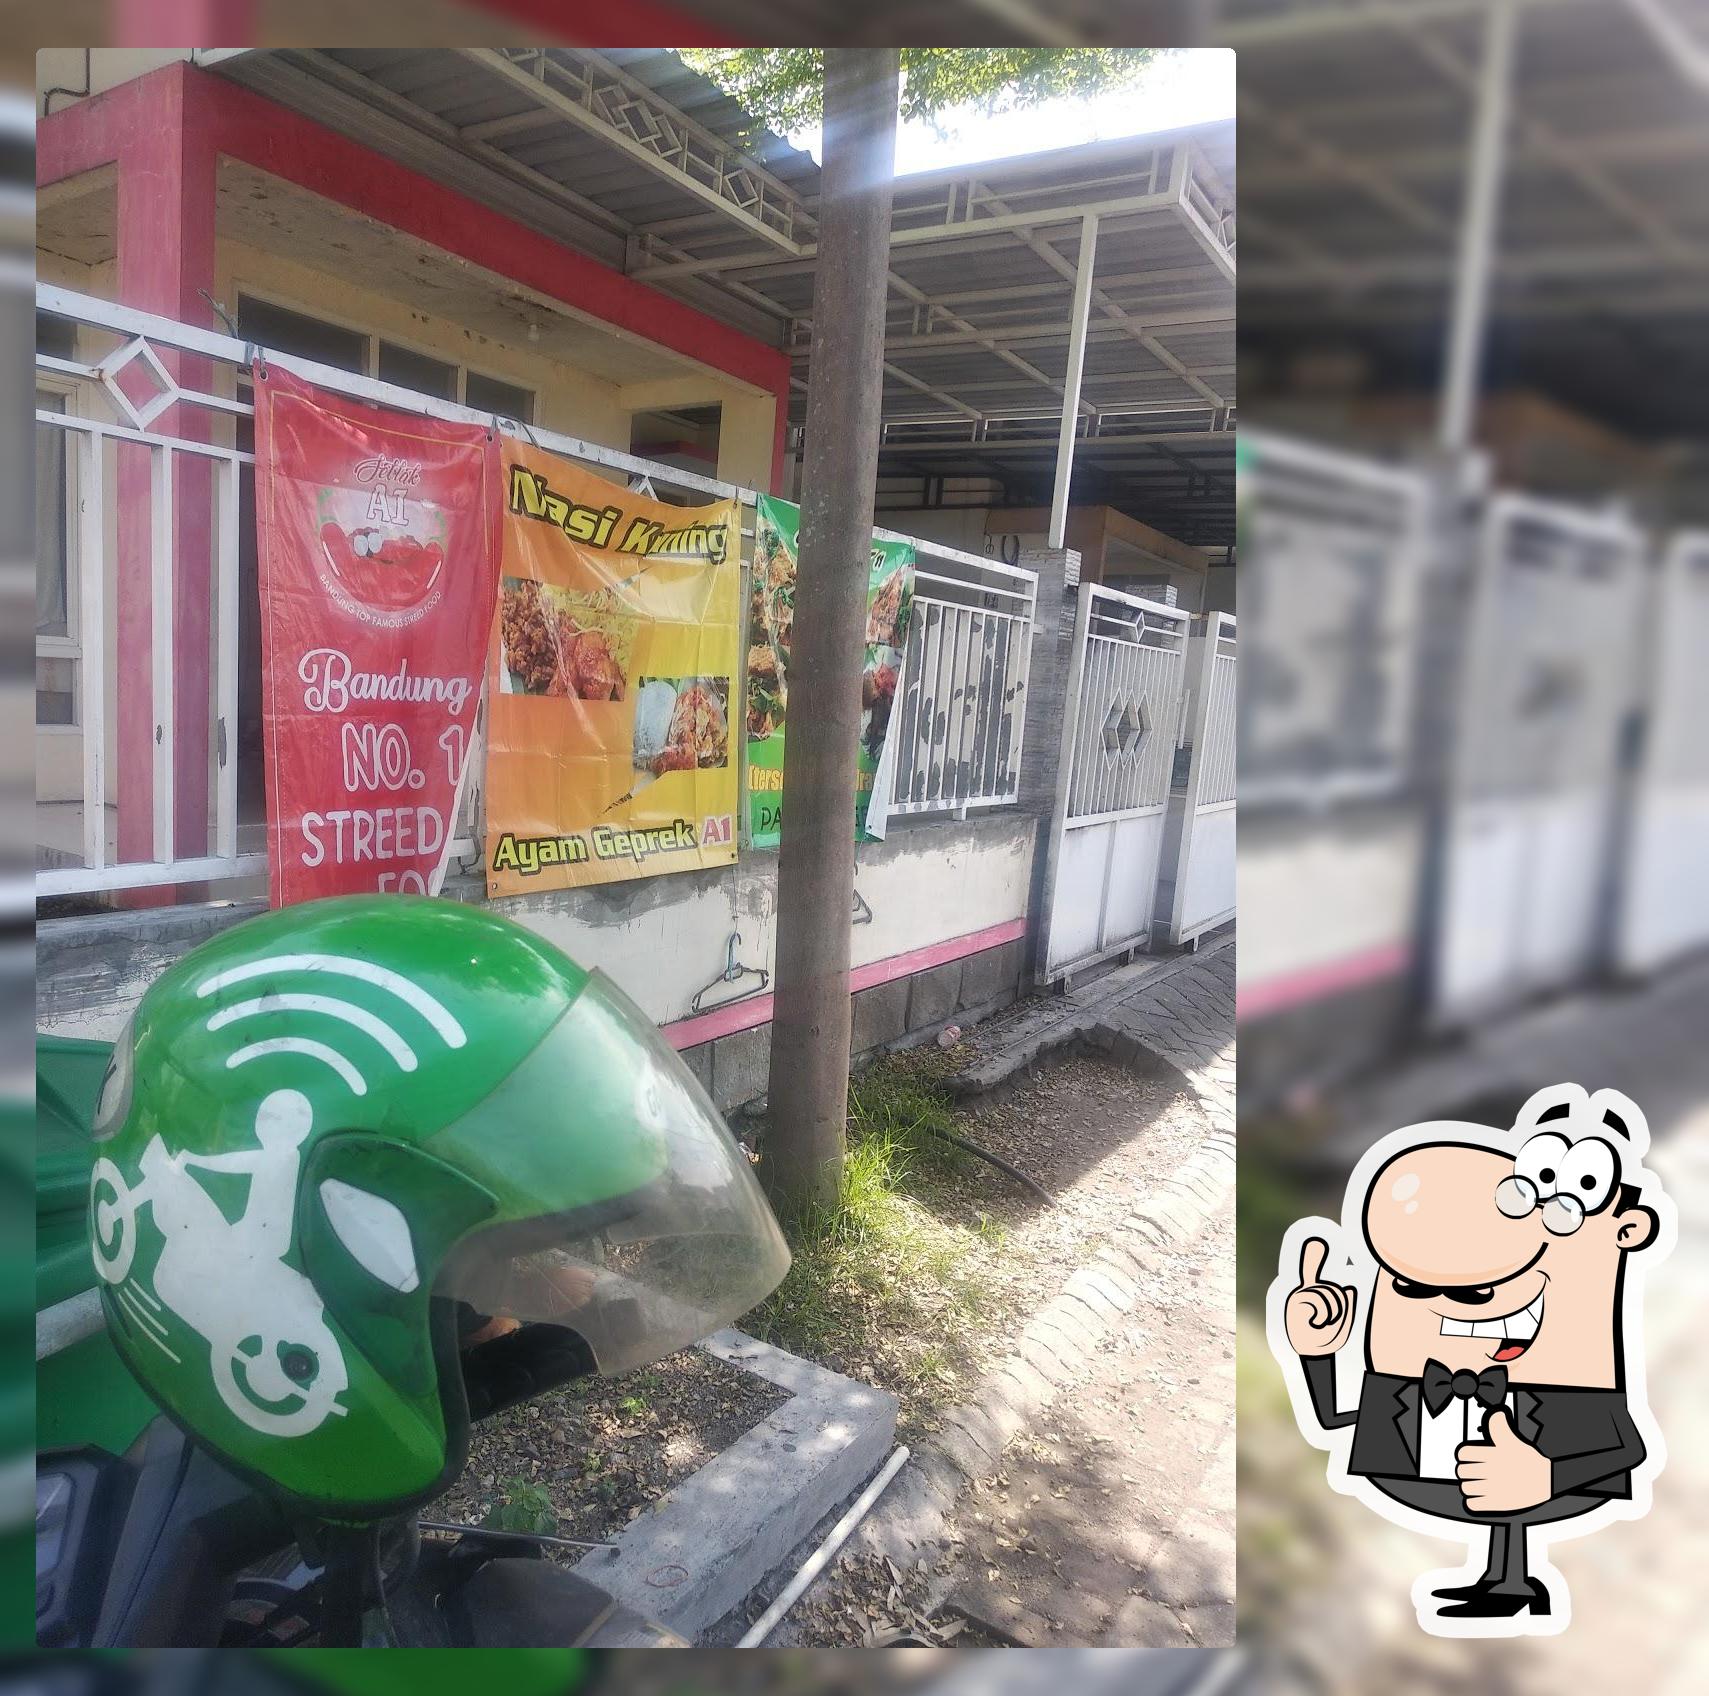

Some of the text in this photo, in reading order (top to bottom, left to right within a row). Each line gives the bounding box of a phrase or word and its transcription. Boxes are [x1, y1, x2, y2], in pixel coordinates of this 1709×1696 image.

[510, 464, 623, 549] Nasi
[320, 574, 355, 614] BANDUNG
[356, 608, 371, 623] TOP
[372, 616, 404, 629] FAMOUS
[298, 648, 472, 715] Bandung
[341, 722, 464, 792] NO. 1
[301, 806, 443, 867] STREED
[492, 815, 732, 876] Ayam Geprek A1
